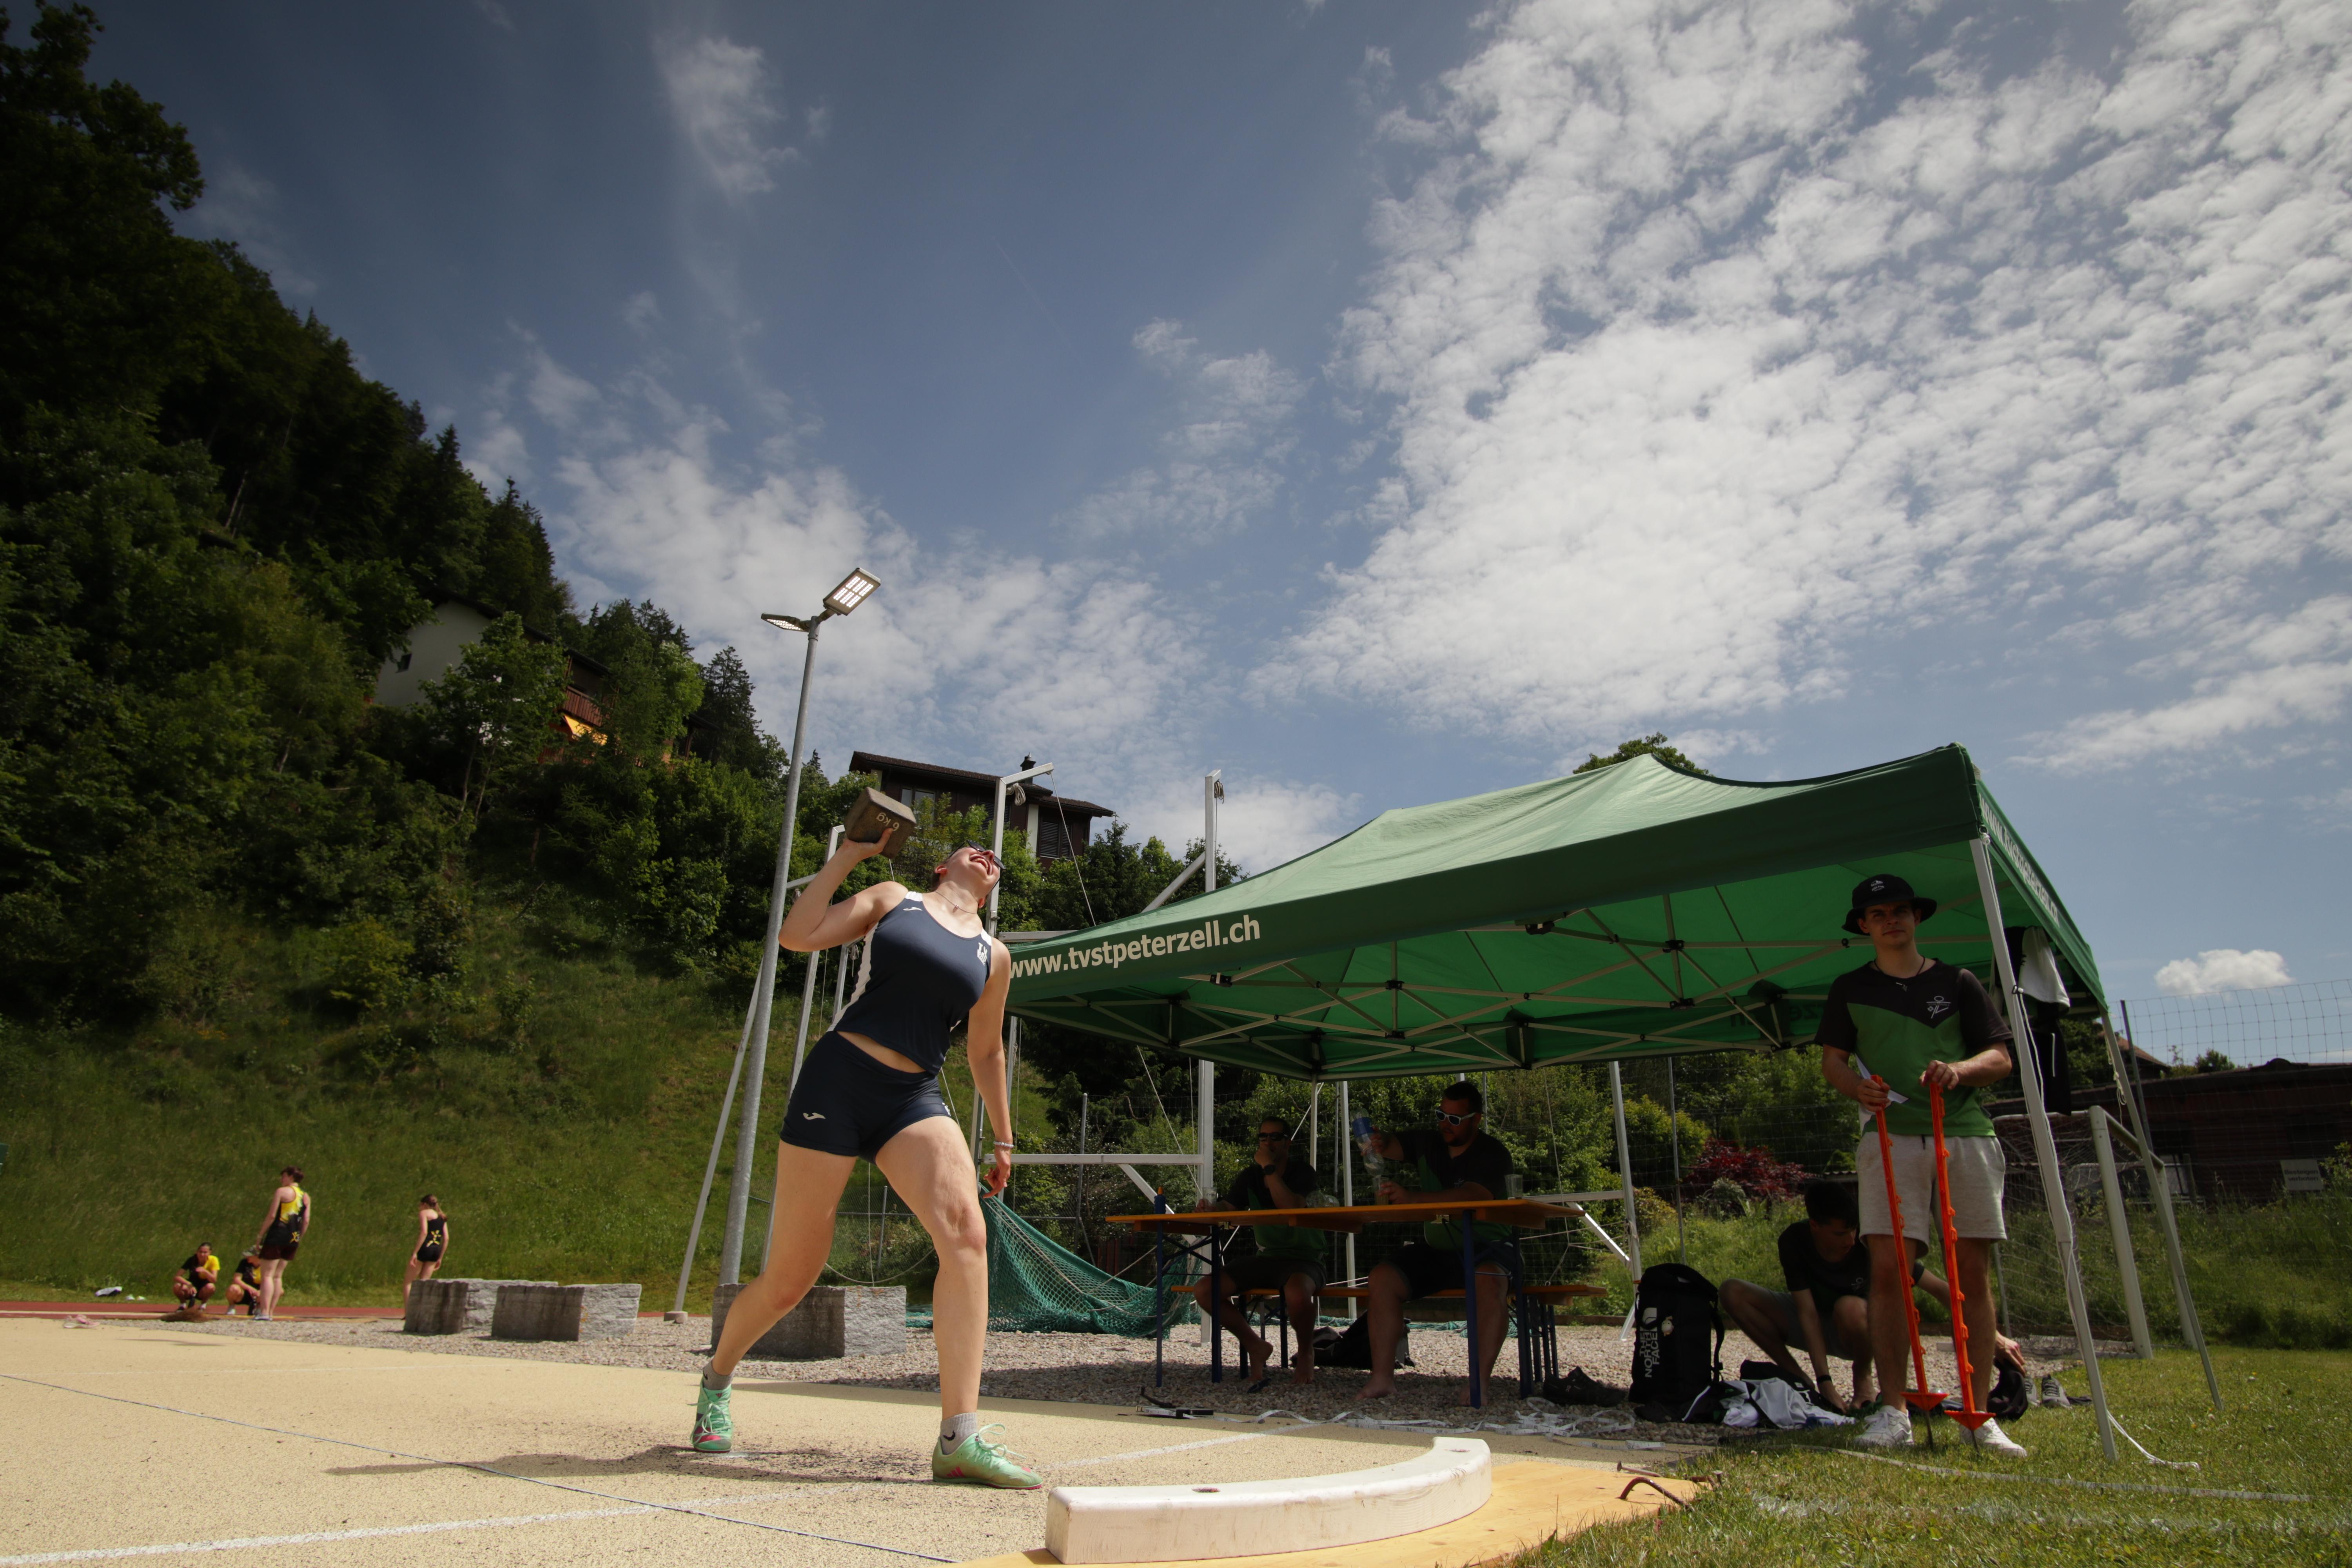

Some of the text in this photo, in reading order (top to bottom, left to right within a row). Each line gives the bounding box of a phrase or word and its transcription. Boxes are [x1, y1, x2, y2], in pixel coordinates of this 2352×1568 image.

[876, 812, 891, 826] kg
[1010, 915, 1260, 979] www.tvstpeterzell.ch
[1644, 1332, 1653, 1377] NORTH
[1650, 1332, 1660, 1365] FACE
